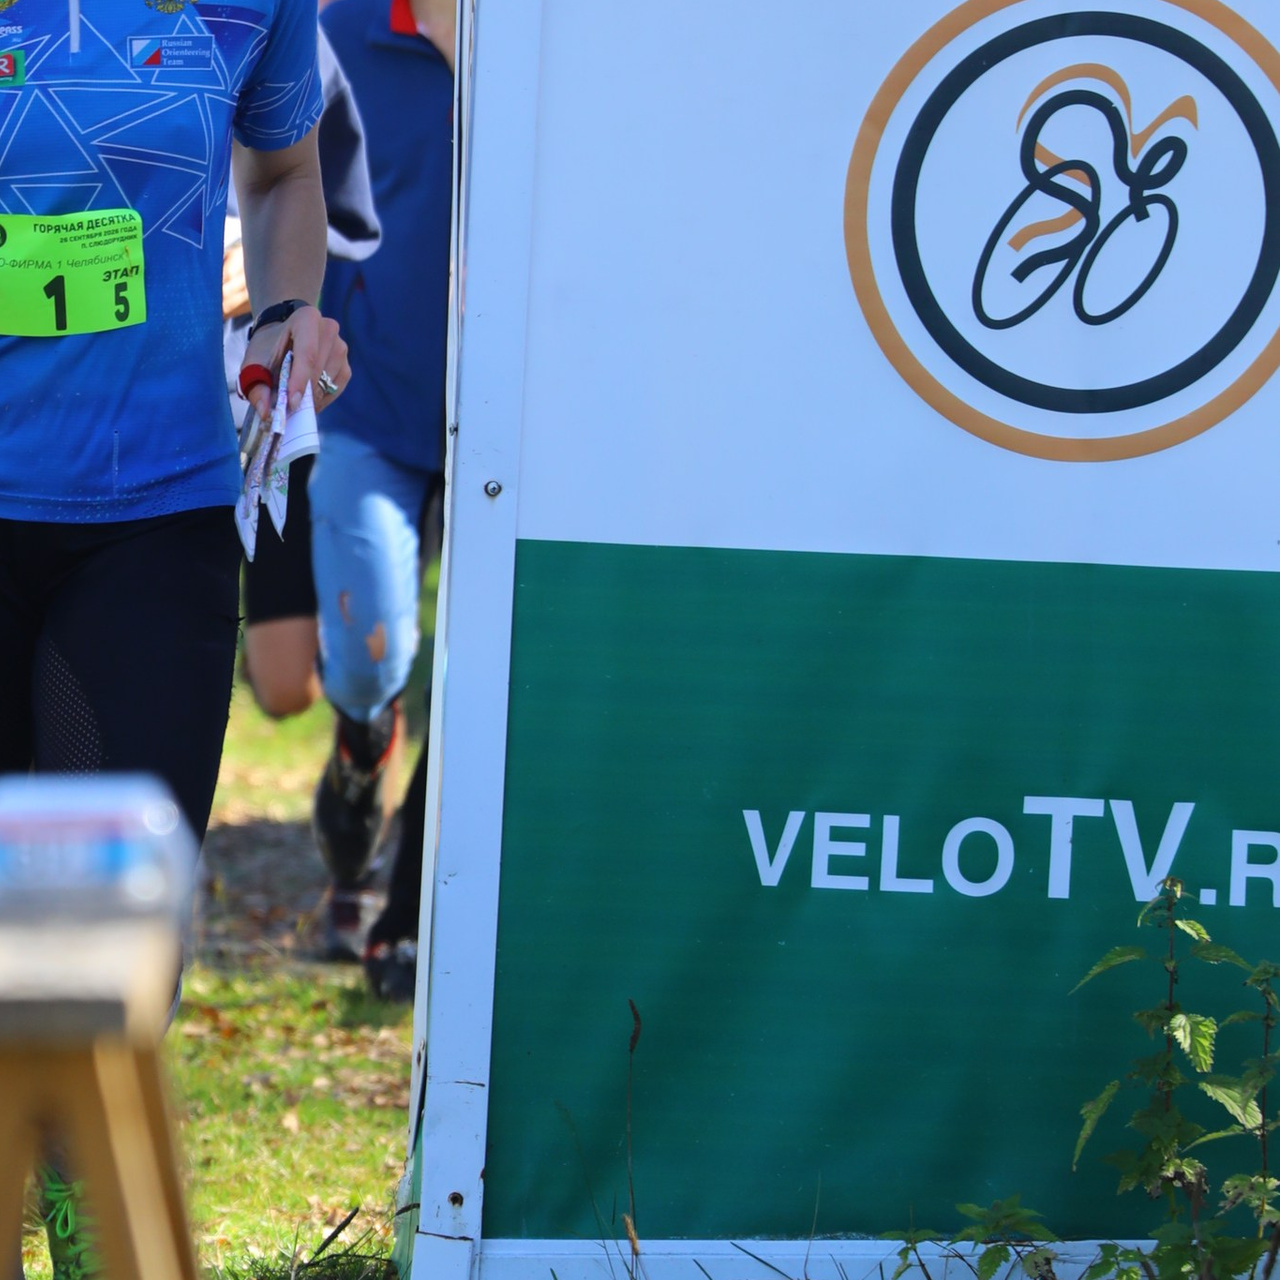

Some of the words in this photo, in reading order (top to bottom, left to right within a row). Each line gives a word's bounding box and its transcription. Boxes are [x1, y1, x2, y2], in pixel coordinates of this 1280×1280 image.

[161, 39, 193, 47] Russian
[161, 48, 211, 58] Orienteering
[163, 58, 184, 66] Team
[33, 220, 84, 234] ГОРЯЧАЯ
[86, 213, 137, 231] ДЕСЯТКА
[69, 231, 102, 243] СЕНТЯБРЯ
[120, 225, 138, 234] ГОДА
[56, 260, 63, 270] 1
[66, 253, 126, 269] Челябинск
[102, 265, 140, 282] ЭТАП
[43, 274, 67, 332] 1
[114, 281, 130, 322] 5
